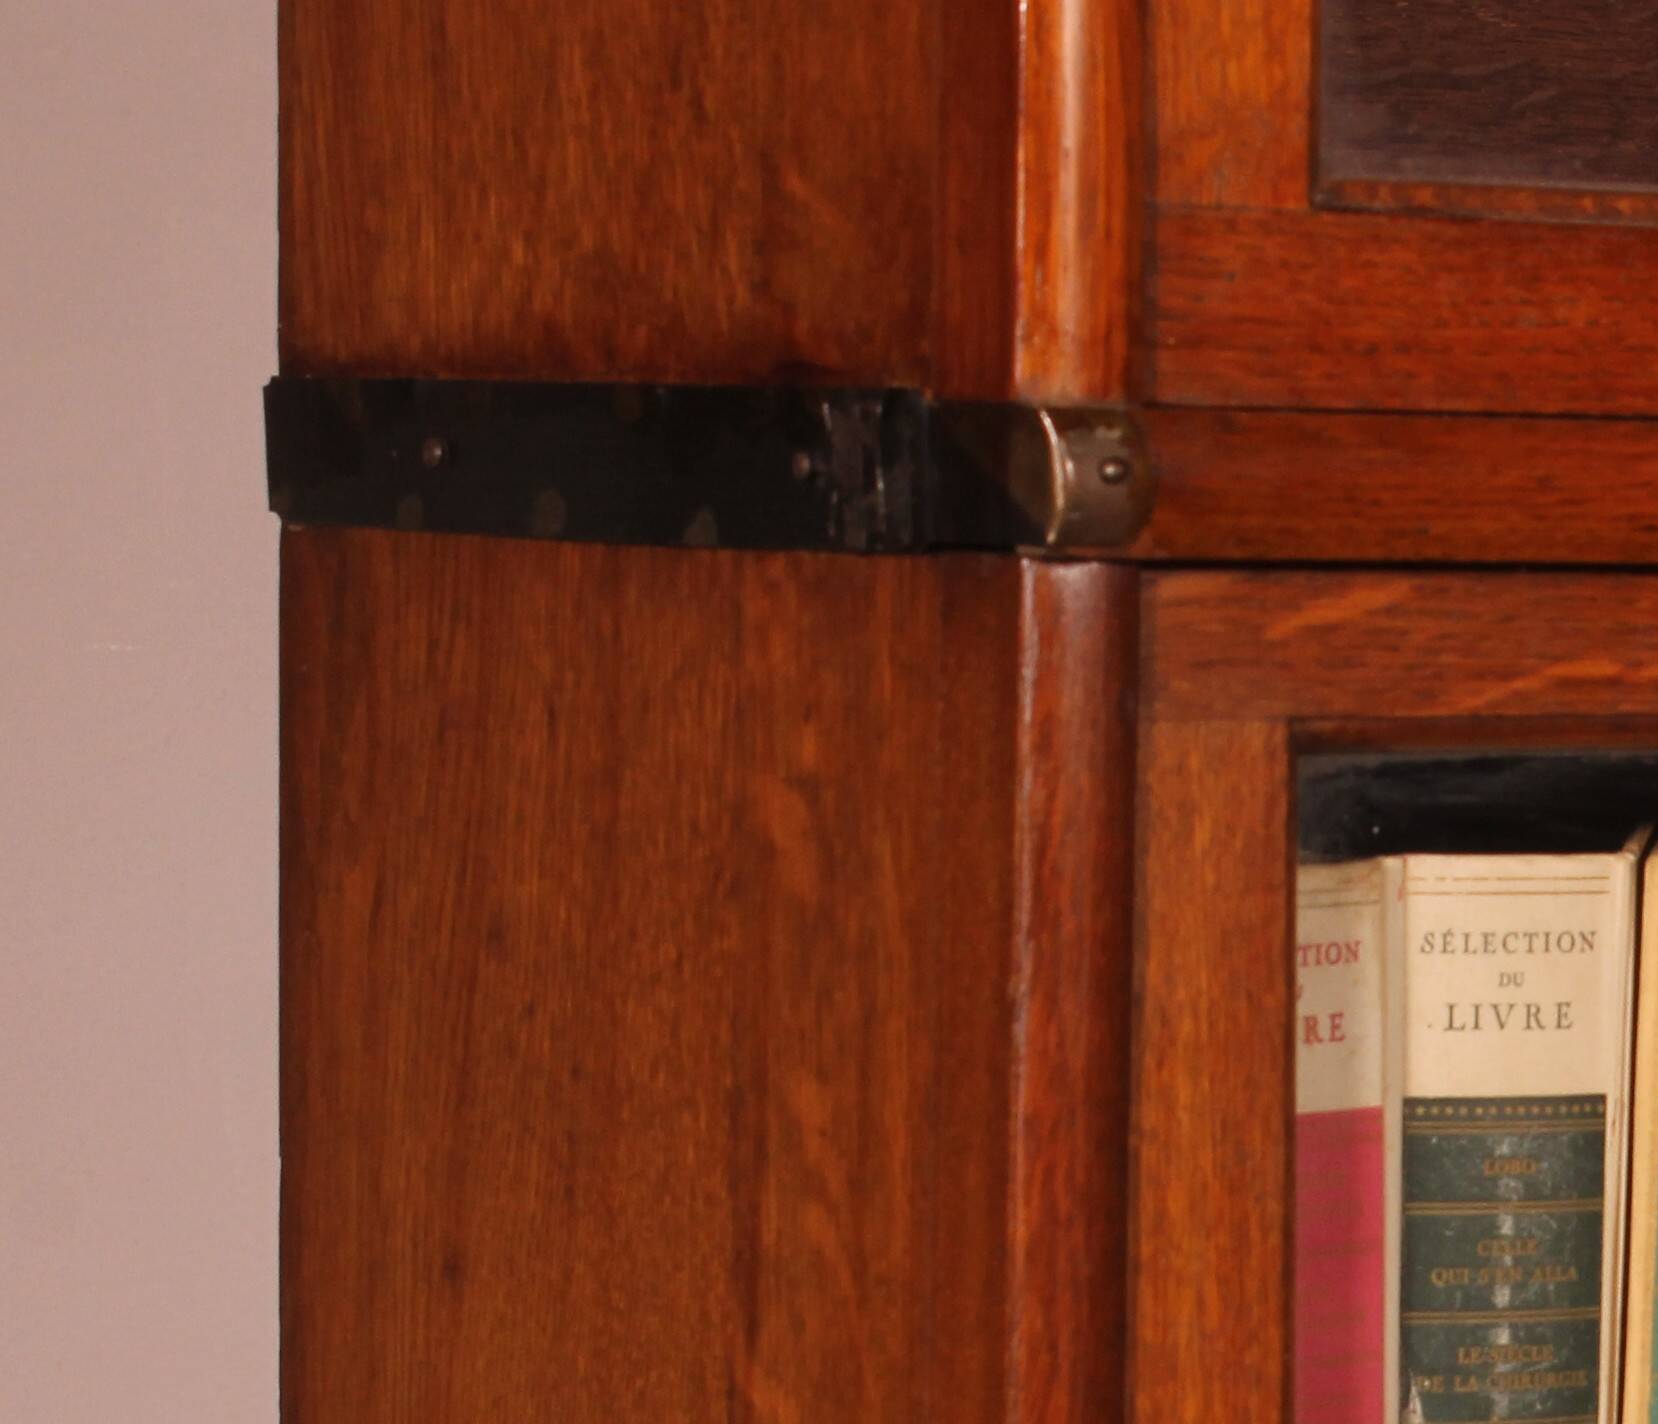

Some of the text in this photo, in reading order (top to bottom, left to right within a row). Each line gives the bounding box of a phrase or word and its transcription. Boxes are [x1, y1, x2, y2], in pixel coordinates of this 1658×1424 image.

[1419, 927, 1598, 955] SÉLECTION
[1296, 940, 1362, 968] TION
[1499, 971, 1525, 988] DU
[1443, 1002, 1574, 1032] LIVRE
[1431, 1267, 1469, 1286] QUI
[1453, 1375, 1479, 1392] LA
